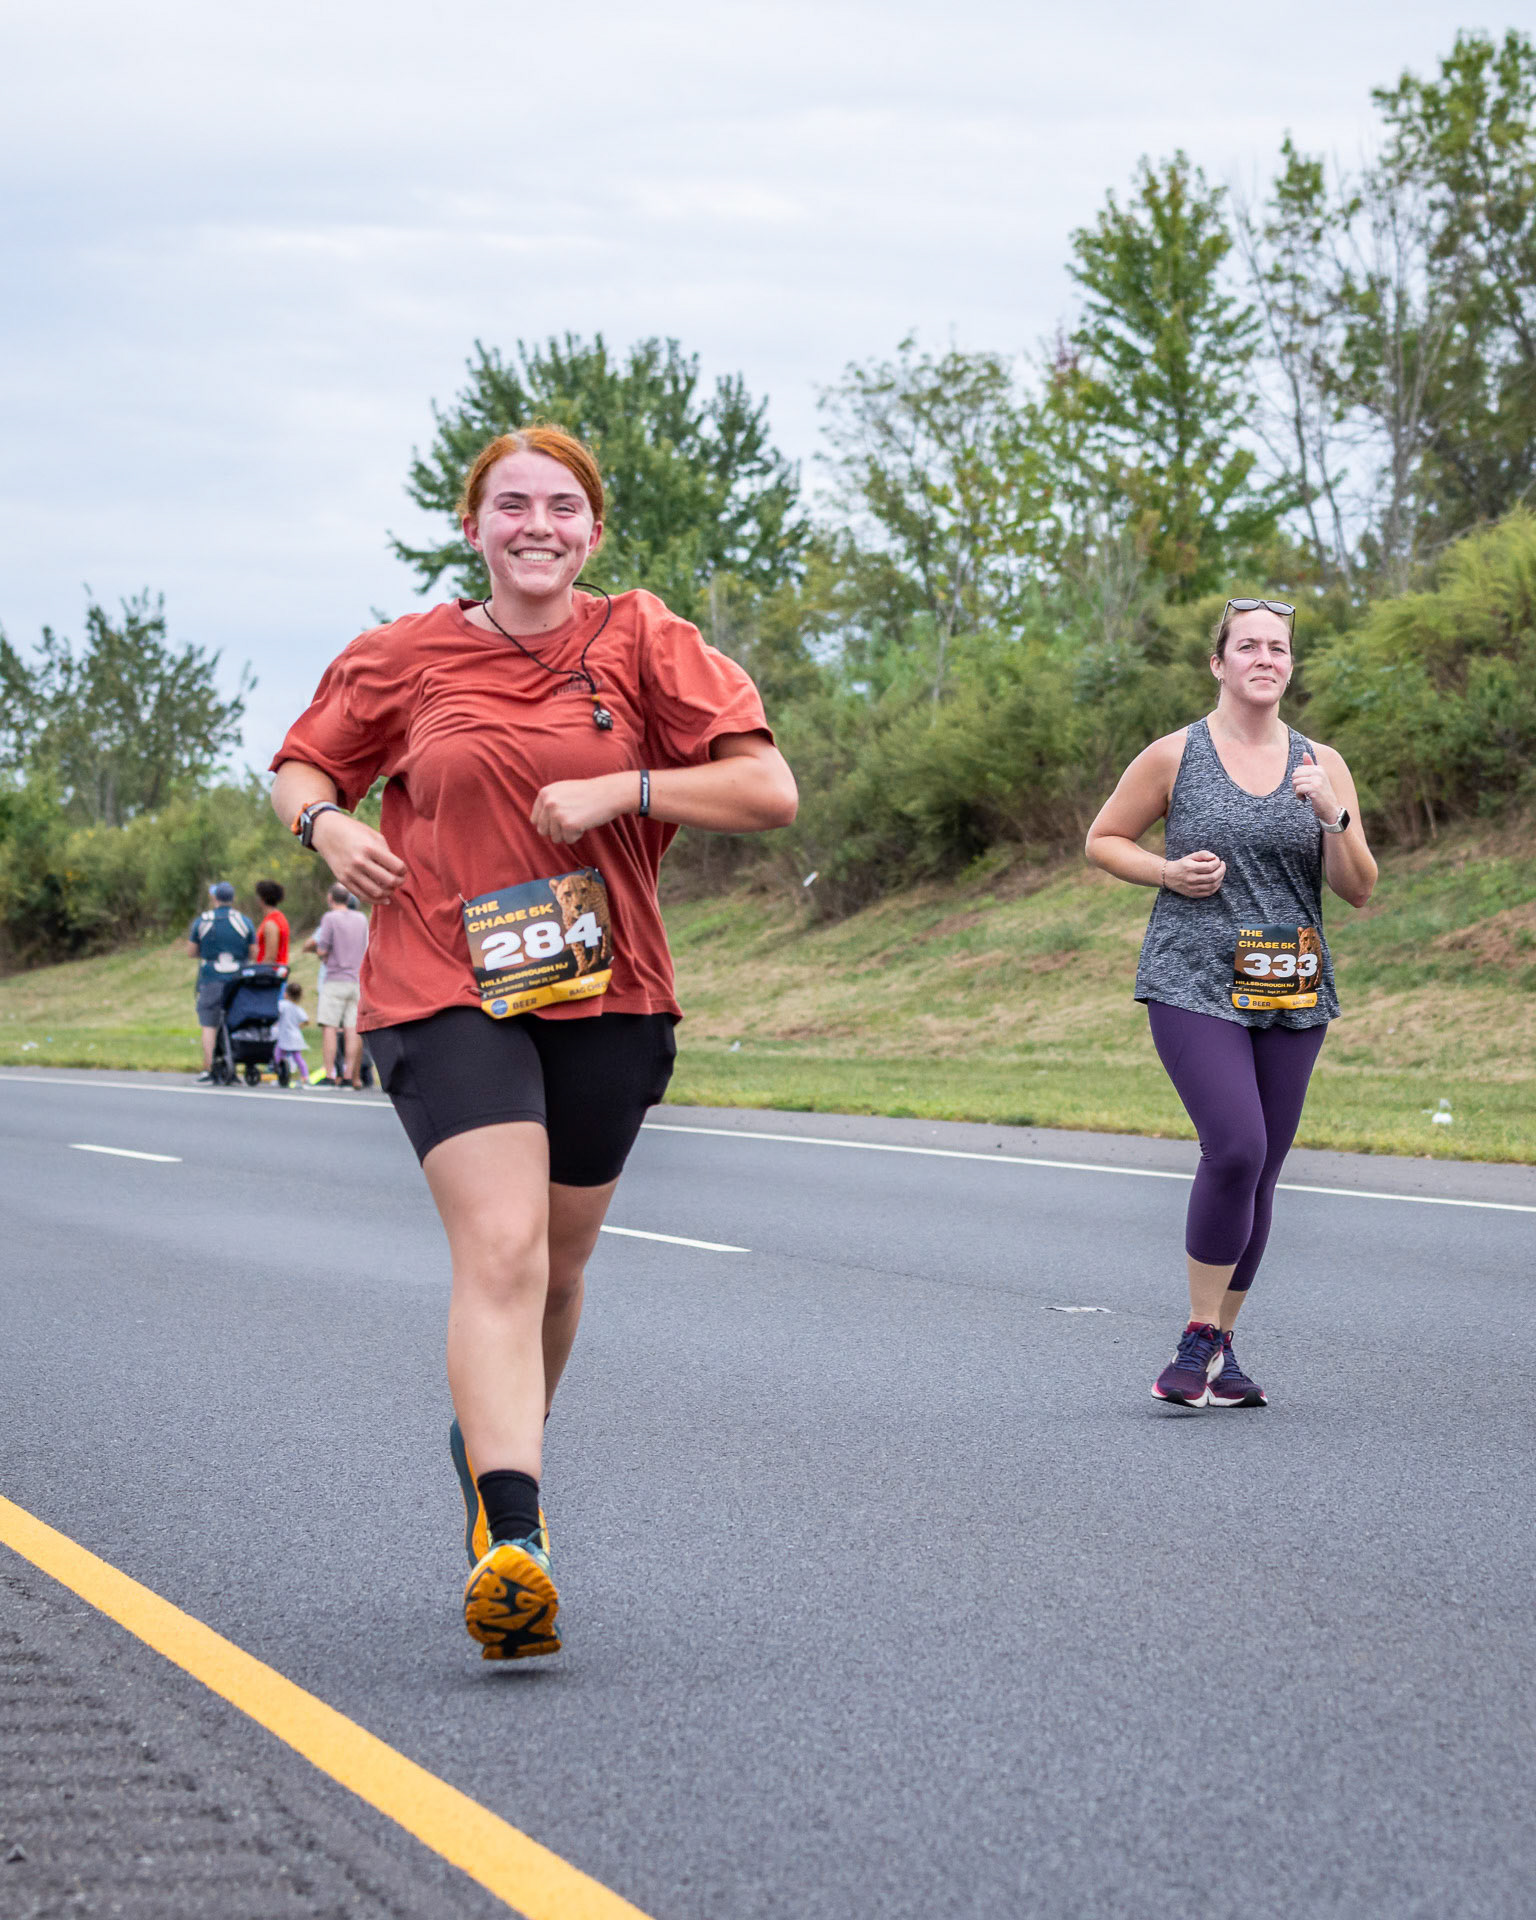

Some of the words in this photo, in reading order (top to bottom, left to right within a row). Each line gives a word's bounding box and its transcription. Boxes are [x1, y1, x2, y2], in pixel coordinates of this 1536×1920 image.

[465, 901, 499, 918] THE
[468, 909, 528, 933] CHASE
[528, 903, 554, 917] 5K
[1239, 929, 1263, 938] THE
[481, 912, 602, 972] 284
[1238, 940, 1280, 949] CHASE
[1280, 942, 1296, 950] 5K
[555, 962, 568, 972] NJ
[1243, 952, 1318, 978] 333
[1235, 980, 1286, 988] HILLSBOROUGH
[512, 998, 537, 1010] BEER
